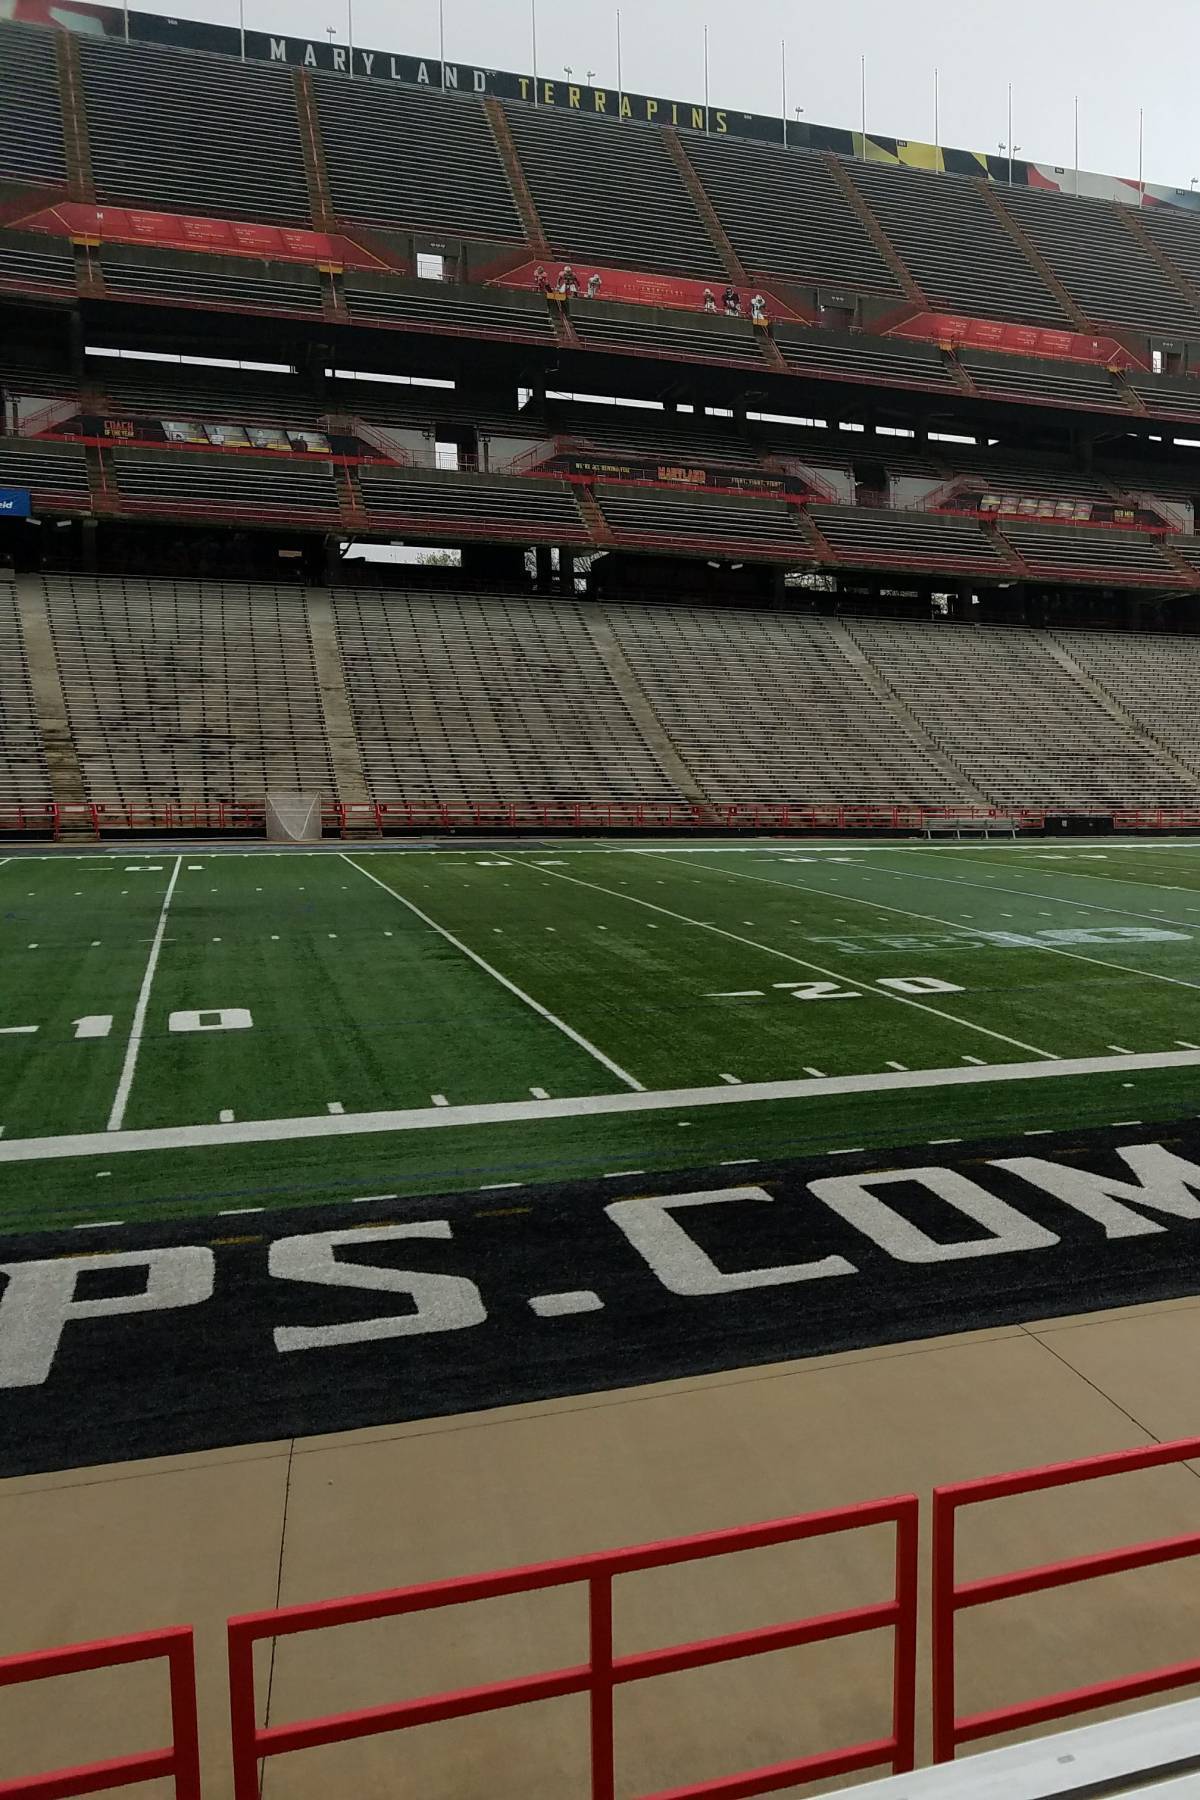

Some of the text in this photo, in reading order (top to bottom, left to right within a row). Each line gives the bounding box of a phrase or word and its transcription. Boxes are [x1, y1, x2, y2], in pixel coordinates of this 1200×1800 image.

[270, 37, 728, 133] MARYLAND TERRAPINS
[772, 976, 966, 1000] 20
[73, 1008, 253, 1038] 10
